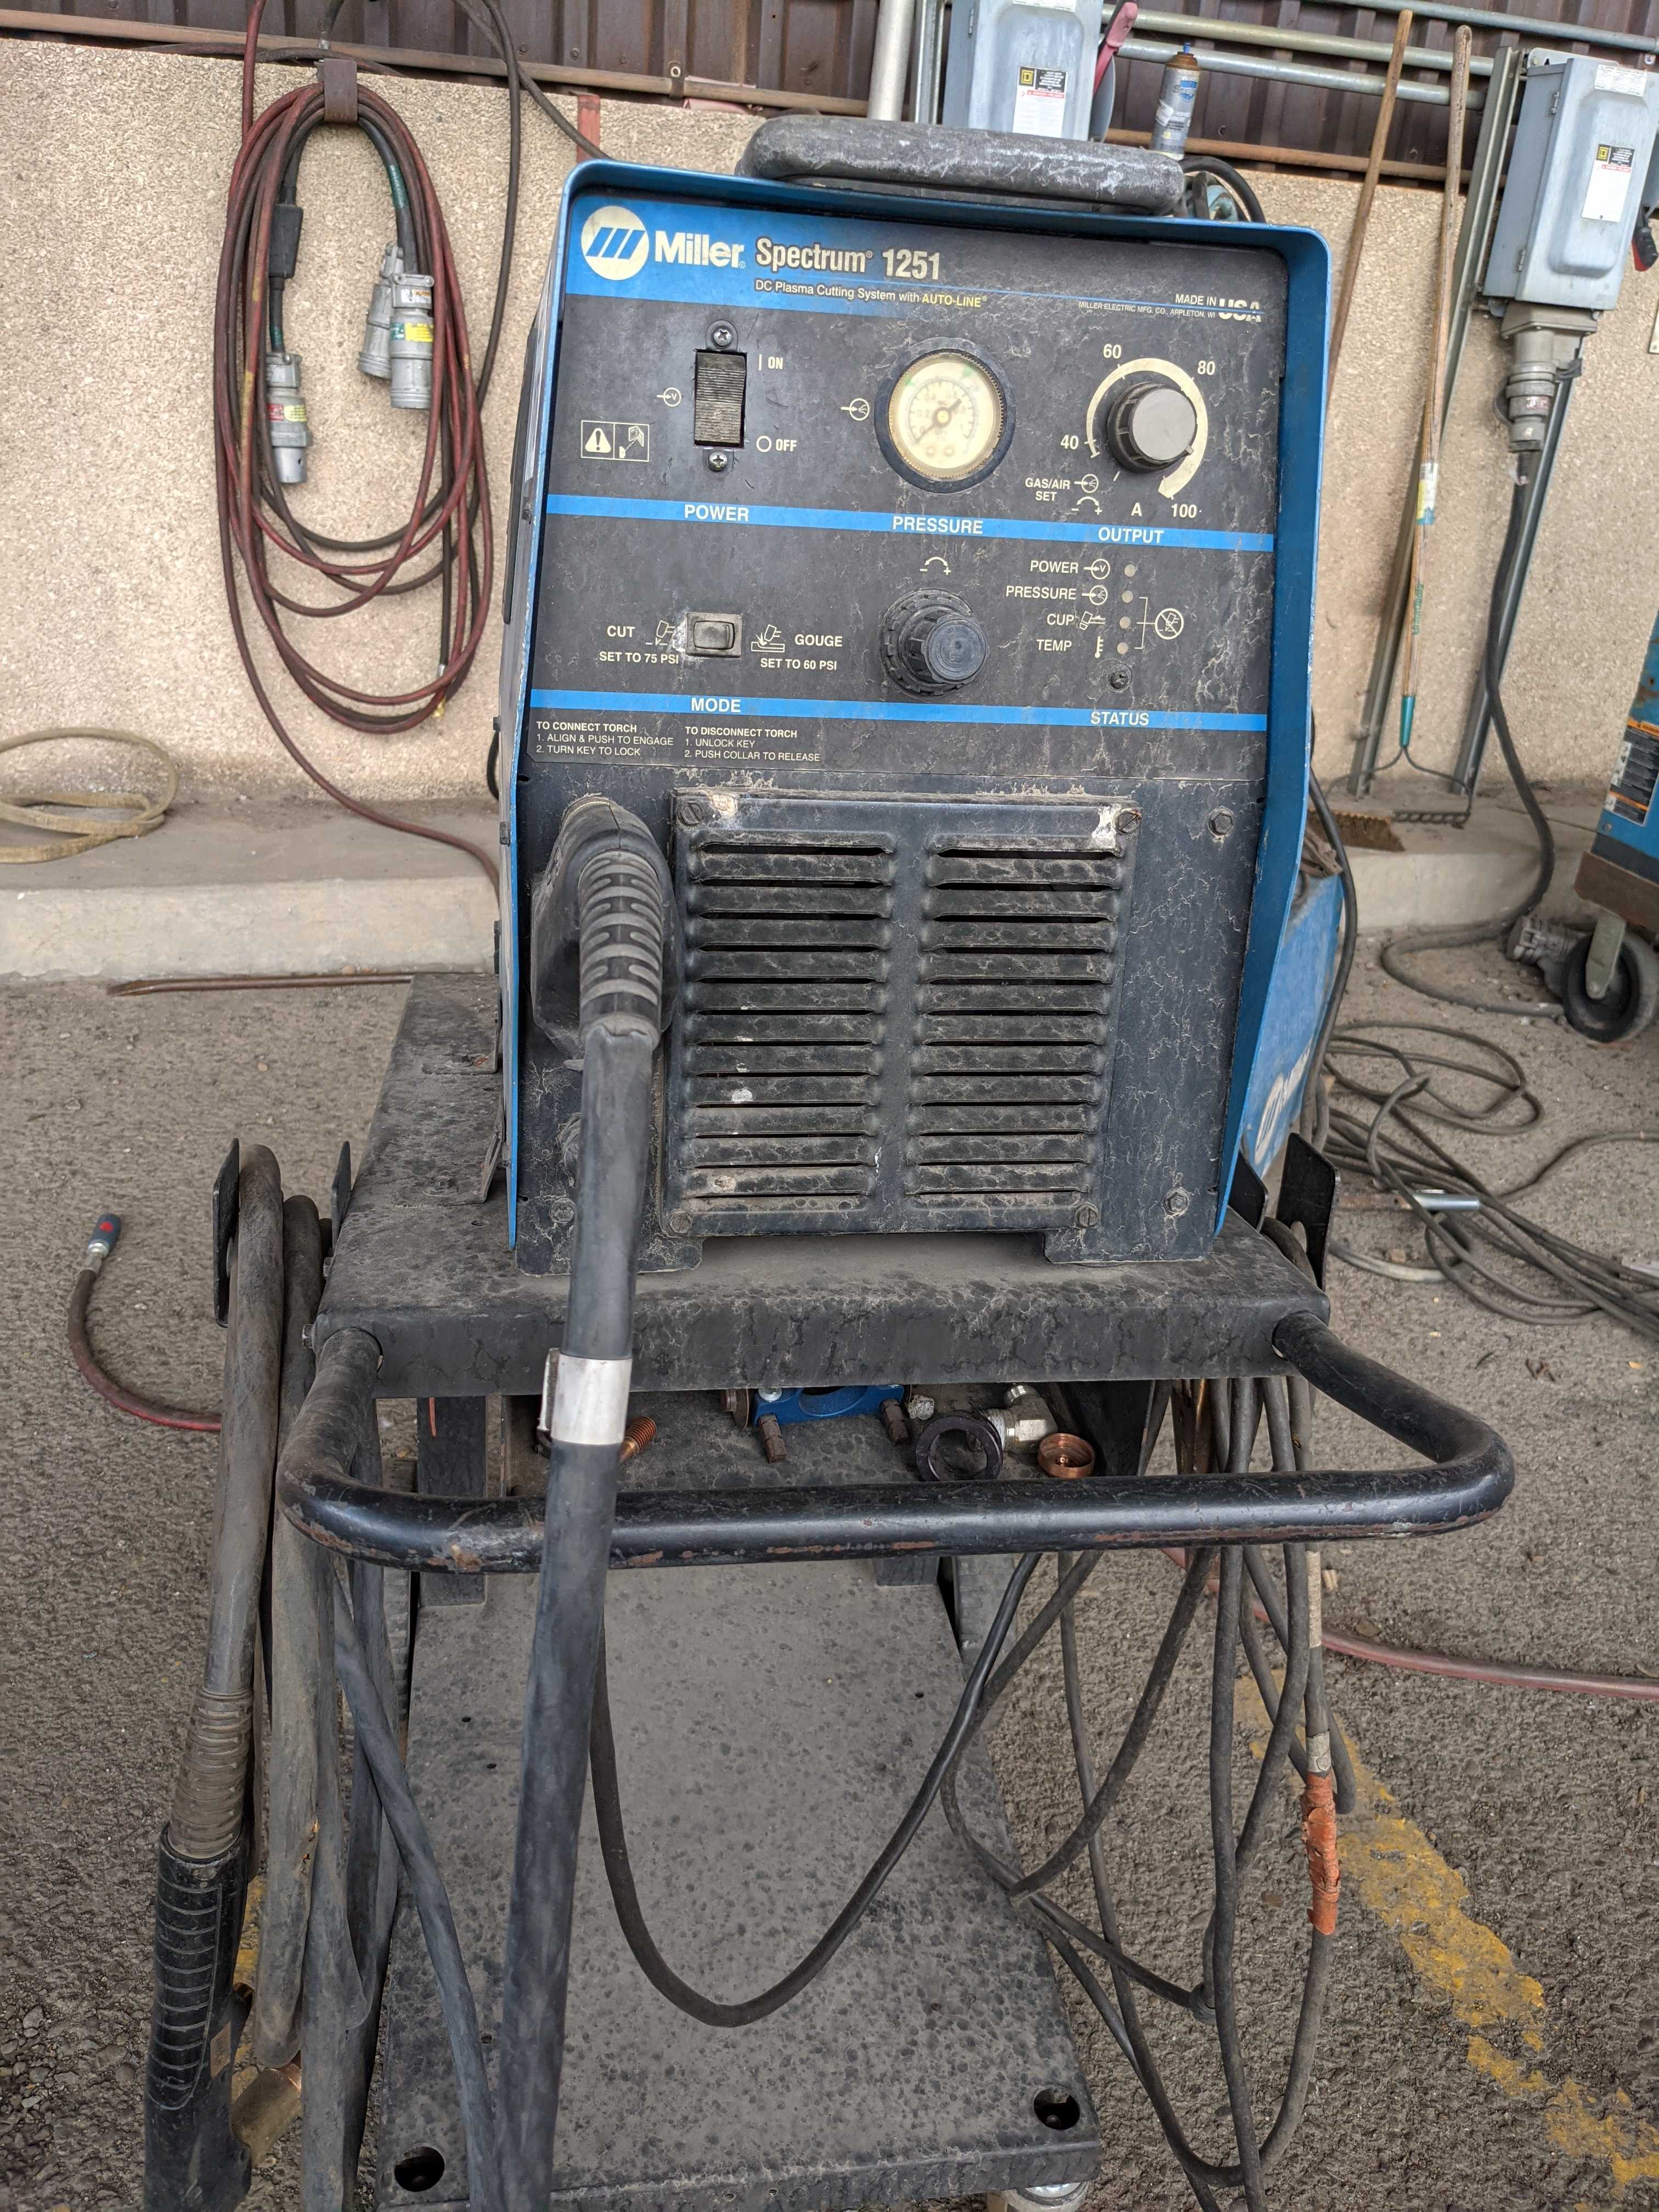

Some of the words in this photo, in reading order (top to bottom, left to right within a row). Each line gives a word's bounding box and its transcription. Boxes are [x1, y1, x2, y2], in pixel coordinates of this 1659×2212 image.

[883, 249, 940, 280] 1251
[755, 280, 772, 291] DC
[775, 281, 814, 295] Plasma
[816, 285, 854, 299] Cutting
[857, 288, 896, 301] System
[899, 291, 920, 302] with
[1079, 302, 1103, 310] MILLER
[1104, 303, 1136, 312] ELECTRIC
[1170, 308, 1206, 318] APPLETON,
[1175, 294, 1206, 306] MADE
[1207, 297, 1217, 307] IN
[1218, 298, 1261, 323] USA
[1103, 343, 1122, 359] 60
[768, 357, 783, 370] ON
[1197, 360, 1216, 376] 80
[776, 439, 797, 452] OFF
[1060, 435, 1079, 449] 40
[1025, 478, 1070, 490] GAS/AIR
[1035, 491, 1057, 501] SET
[684, 504, 749, 522] POWER
[1131, 503, 1142, 517] A
[1171, 504, 1197, 518] 100
[892, 516, 983, 535] PRESSURE
[1098, 527, 1164, 544] OUTPUT
[1030, 560, 1079, 574] POWER
[1005, 585, 1077, 601] PRESSURE
[1046, 613, 1075, 627] CUP
[607, 625, 635, 638] CUT
[794, 634, 843, 647] GOUGE
[1036, 639, 1073, 652] TEMP
[599, 651, 622, 663] SET
[625, 652, 641, 663] TO
[644, 653, 658, 664] 75
[661, 653, 679, 665] PSI
[760, 658, 783, 669] SET
[785, 659, 802, 669] TO
[803, 659, 817, 670] 60
[819, 659, 837, 671] PSI
[691, 697, 741, 713] MODE
[1091, 711, 1149, 726] STATUS
[537, 721, 550, 730] TO
[552, 722, 600, 732] CONNECT
[603, 724, 637, 733] TORCH
[685, 726, 698, 735] TO
[701, 727, 763, 737] DISCONNECT
[764, 729, 797, 738] TORCH
[547, 734, 577, 742] ALIGN
[579, 735, 585, 743] &
[588, 735, 615, 744] PUSH
[617, 736, 631, 744] TO
[633, 736, 674, 746] ENGAGE
[695, 738, 734, 748] UNLOCK
[737, 740, 755, 748] KEY
[547, 745, 574, 754] TURN
[577, 746, 596, 755] KEY
[599, 747, 612, 755] TO
[614, 747, 641, 756] LOCK
[695, 750, 721, 759] PUSH
[723, 751, 760, 760] COLLAR
[763, 752, 776, 760] TO
[778, 752, 821, 761] RELEASE
